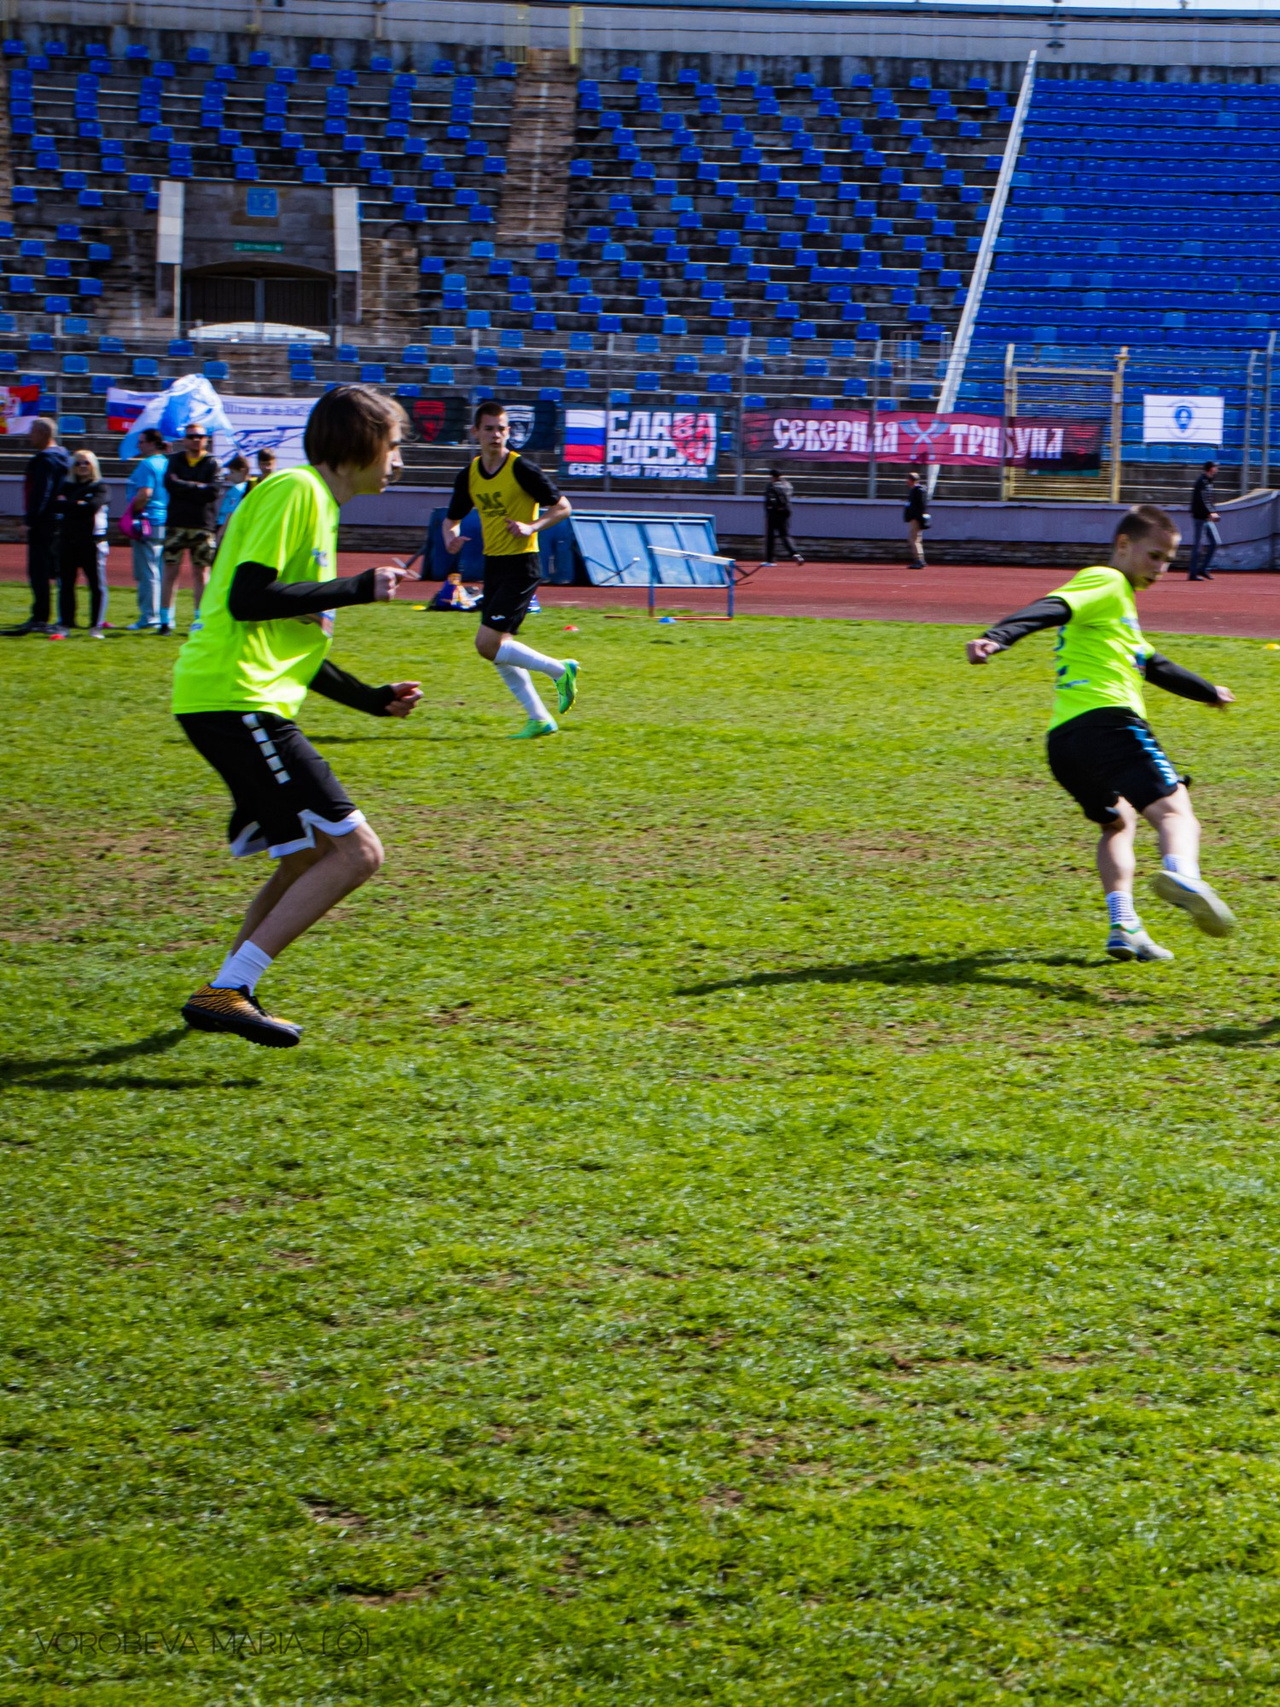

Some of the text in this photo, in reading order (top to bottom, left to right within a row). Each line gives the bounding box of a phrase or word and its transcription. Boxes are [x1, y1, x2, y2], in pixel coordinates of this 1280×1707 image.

[608, 411, 717, 440] СЛАВА
[773, 418, 899, 453] СЕВЕРНАЯ
[607, 439, 716, 466] РОССИИ
